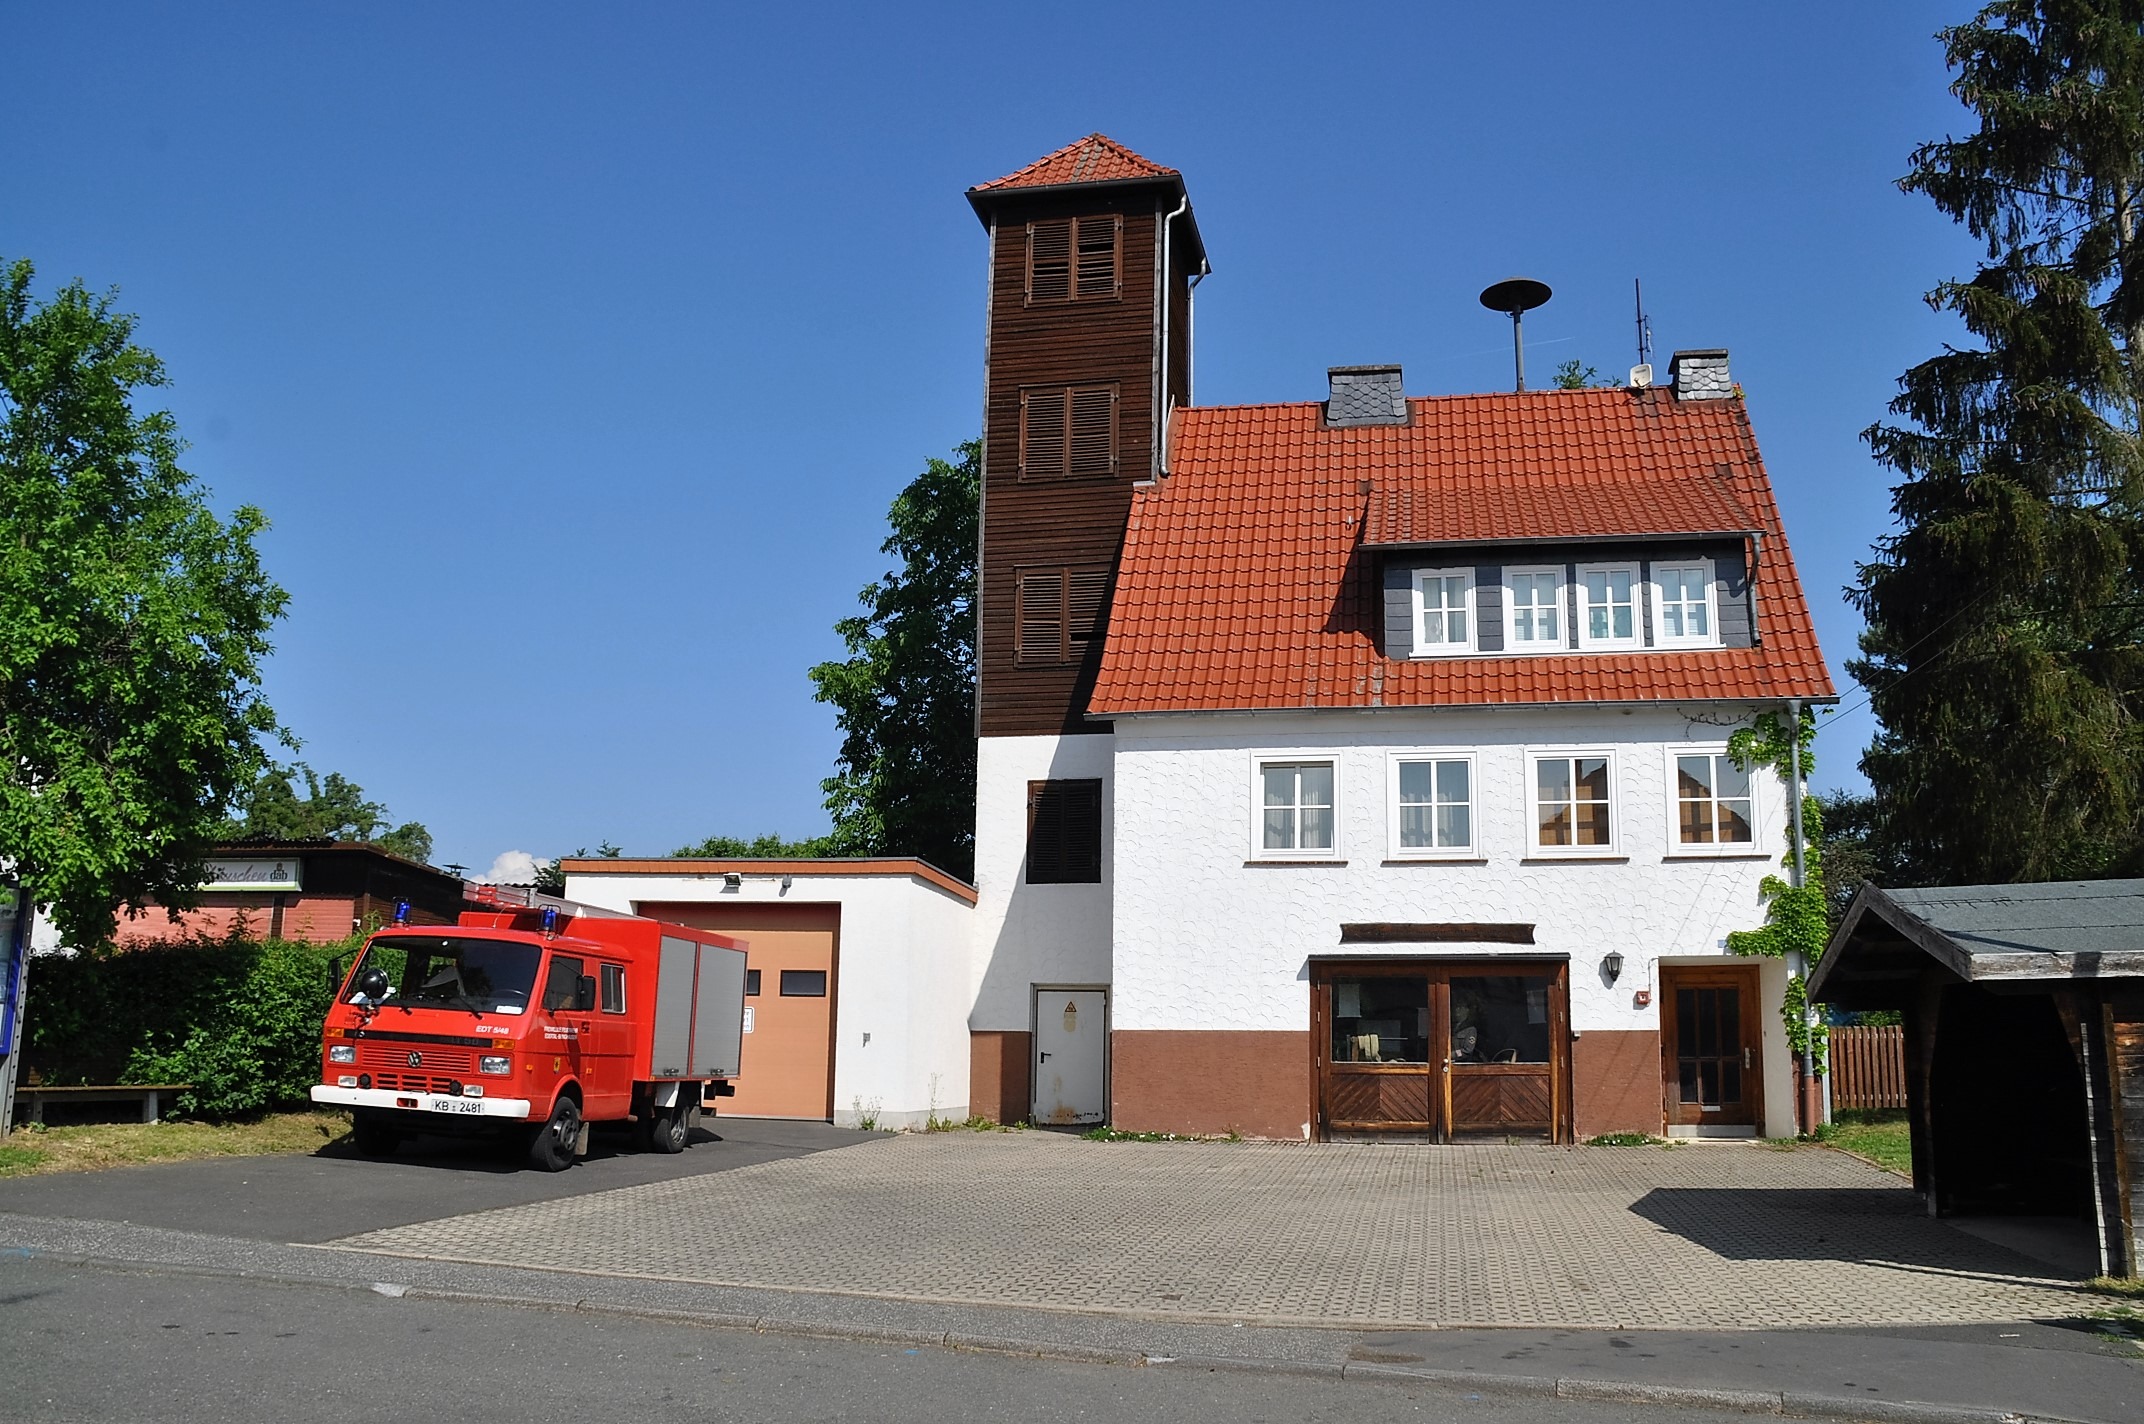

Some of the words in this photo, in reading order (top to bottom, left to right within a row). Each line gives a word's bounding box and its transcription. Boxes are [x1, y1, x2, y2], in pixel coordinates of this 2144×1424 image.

[475, 1025, 492, 1033] EDT
[435, 1100, 449, 1111] KB
[459, 1102, 481, 1113] 2481
